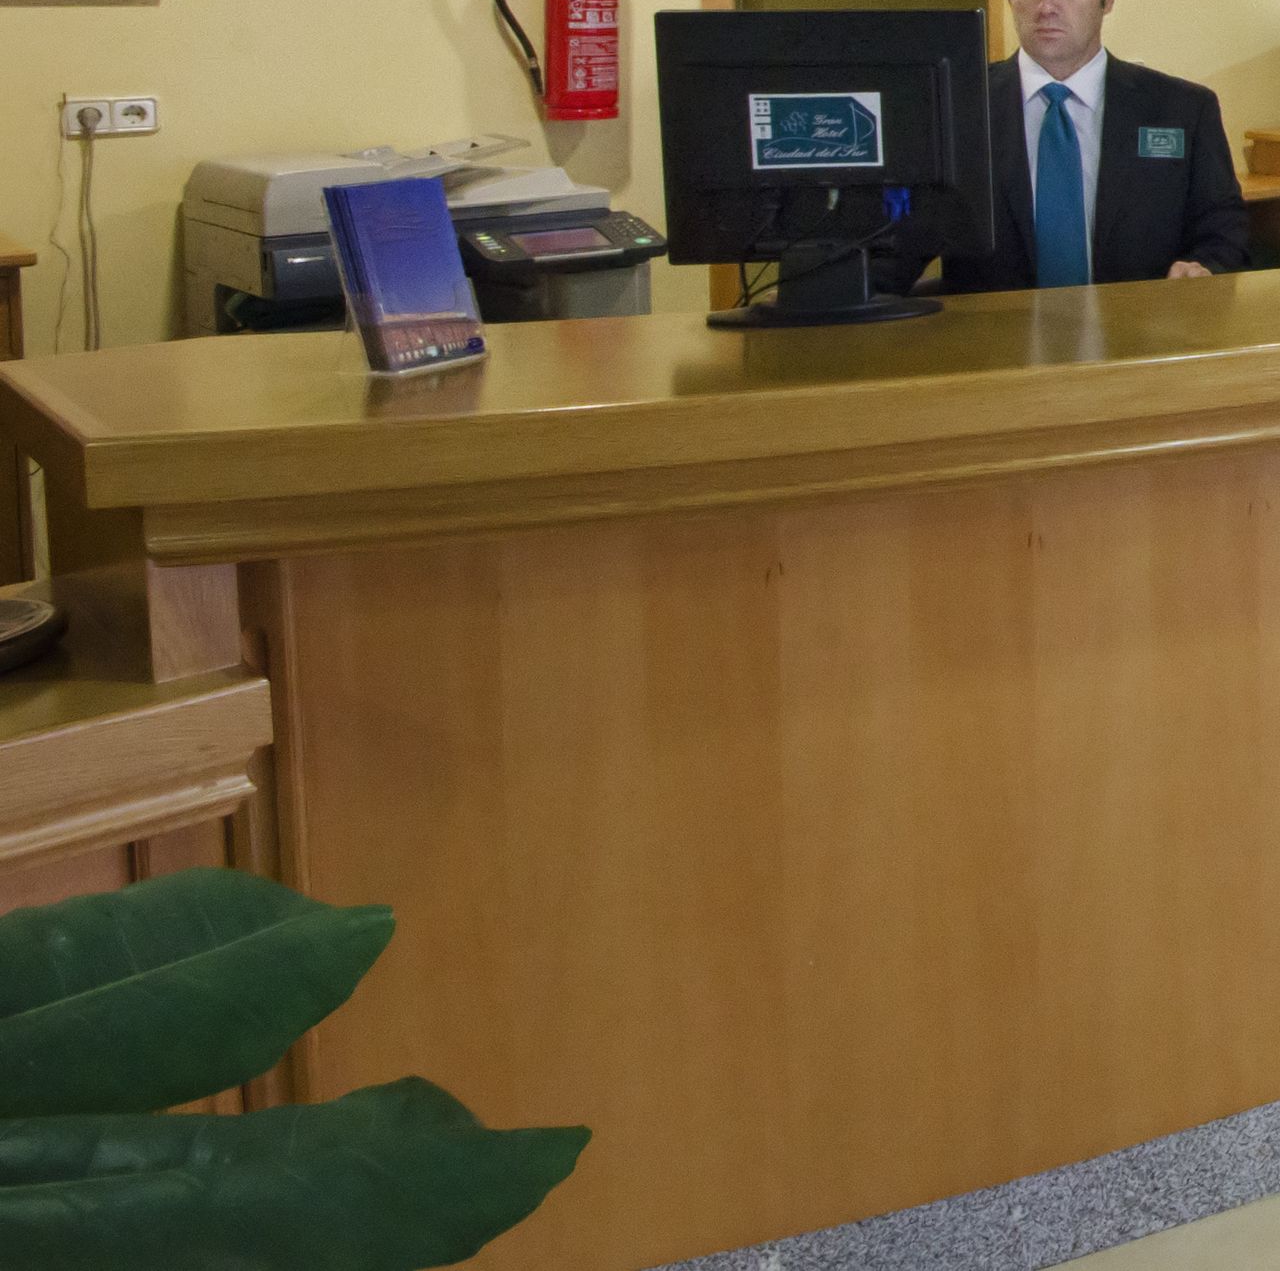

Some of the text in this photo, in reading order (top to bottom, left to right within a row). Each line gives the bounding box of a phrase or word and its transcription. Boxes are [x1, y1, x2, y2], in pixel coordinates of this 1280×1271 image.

[812, 114, 842, 125] Gran
[811, 127, 849, 138] Hotel
[762, 147, 816, 159] Ciudad
[815, 147, 842, 157] del
